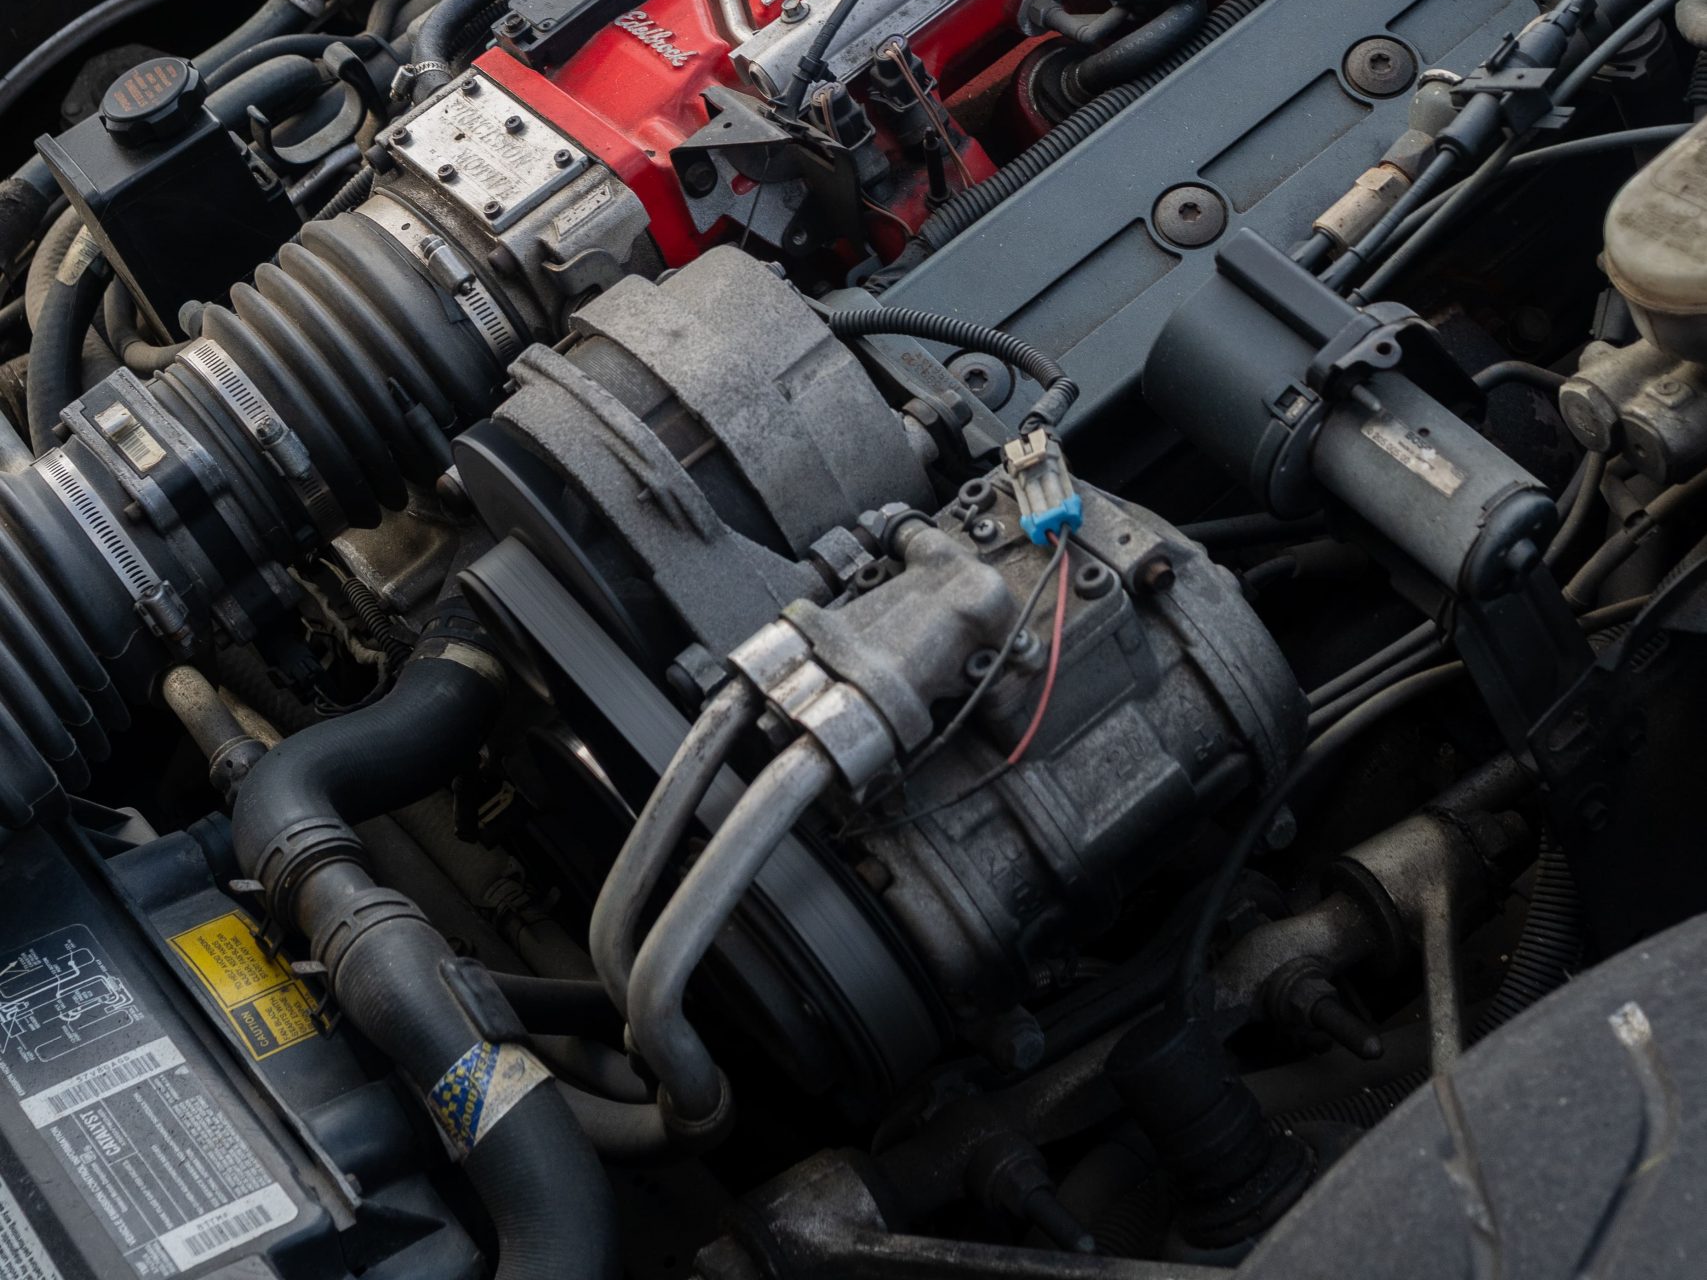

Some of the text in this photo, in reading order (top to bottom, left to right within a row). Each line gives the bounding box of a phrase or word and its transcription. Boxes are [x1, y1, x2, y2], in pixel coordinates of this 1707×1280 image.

[614, 10, 699, 68] Edelbrock
[446, 100, 539, 170] PRECISION
[452, 149, 522, 201] MOTIVE
[240, 1009, 269, 1047] CAUTION
[264, 1006, 281, 1027] BLADE
[278, 1012, 298, 1037] STARTS
[48, 1124, 82, 1166] INFORMATION
[79, 1108, 121, 1157] CATALYST
[74, 1162, 100, 1193] CONTROL
[0, 1209, 13, 1224] any
[93, 1189, 120, 1221] EMISSION
[0, 1230, 26, 1265] diagnostic
[4, 1221, 35, 1258] performing
[113, 1217, 137, 1246] VEHICLE
[18, 1264, 28, 1275] for
[25, 1256, 44, 1278] before
